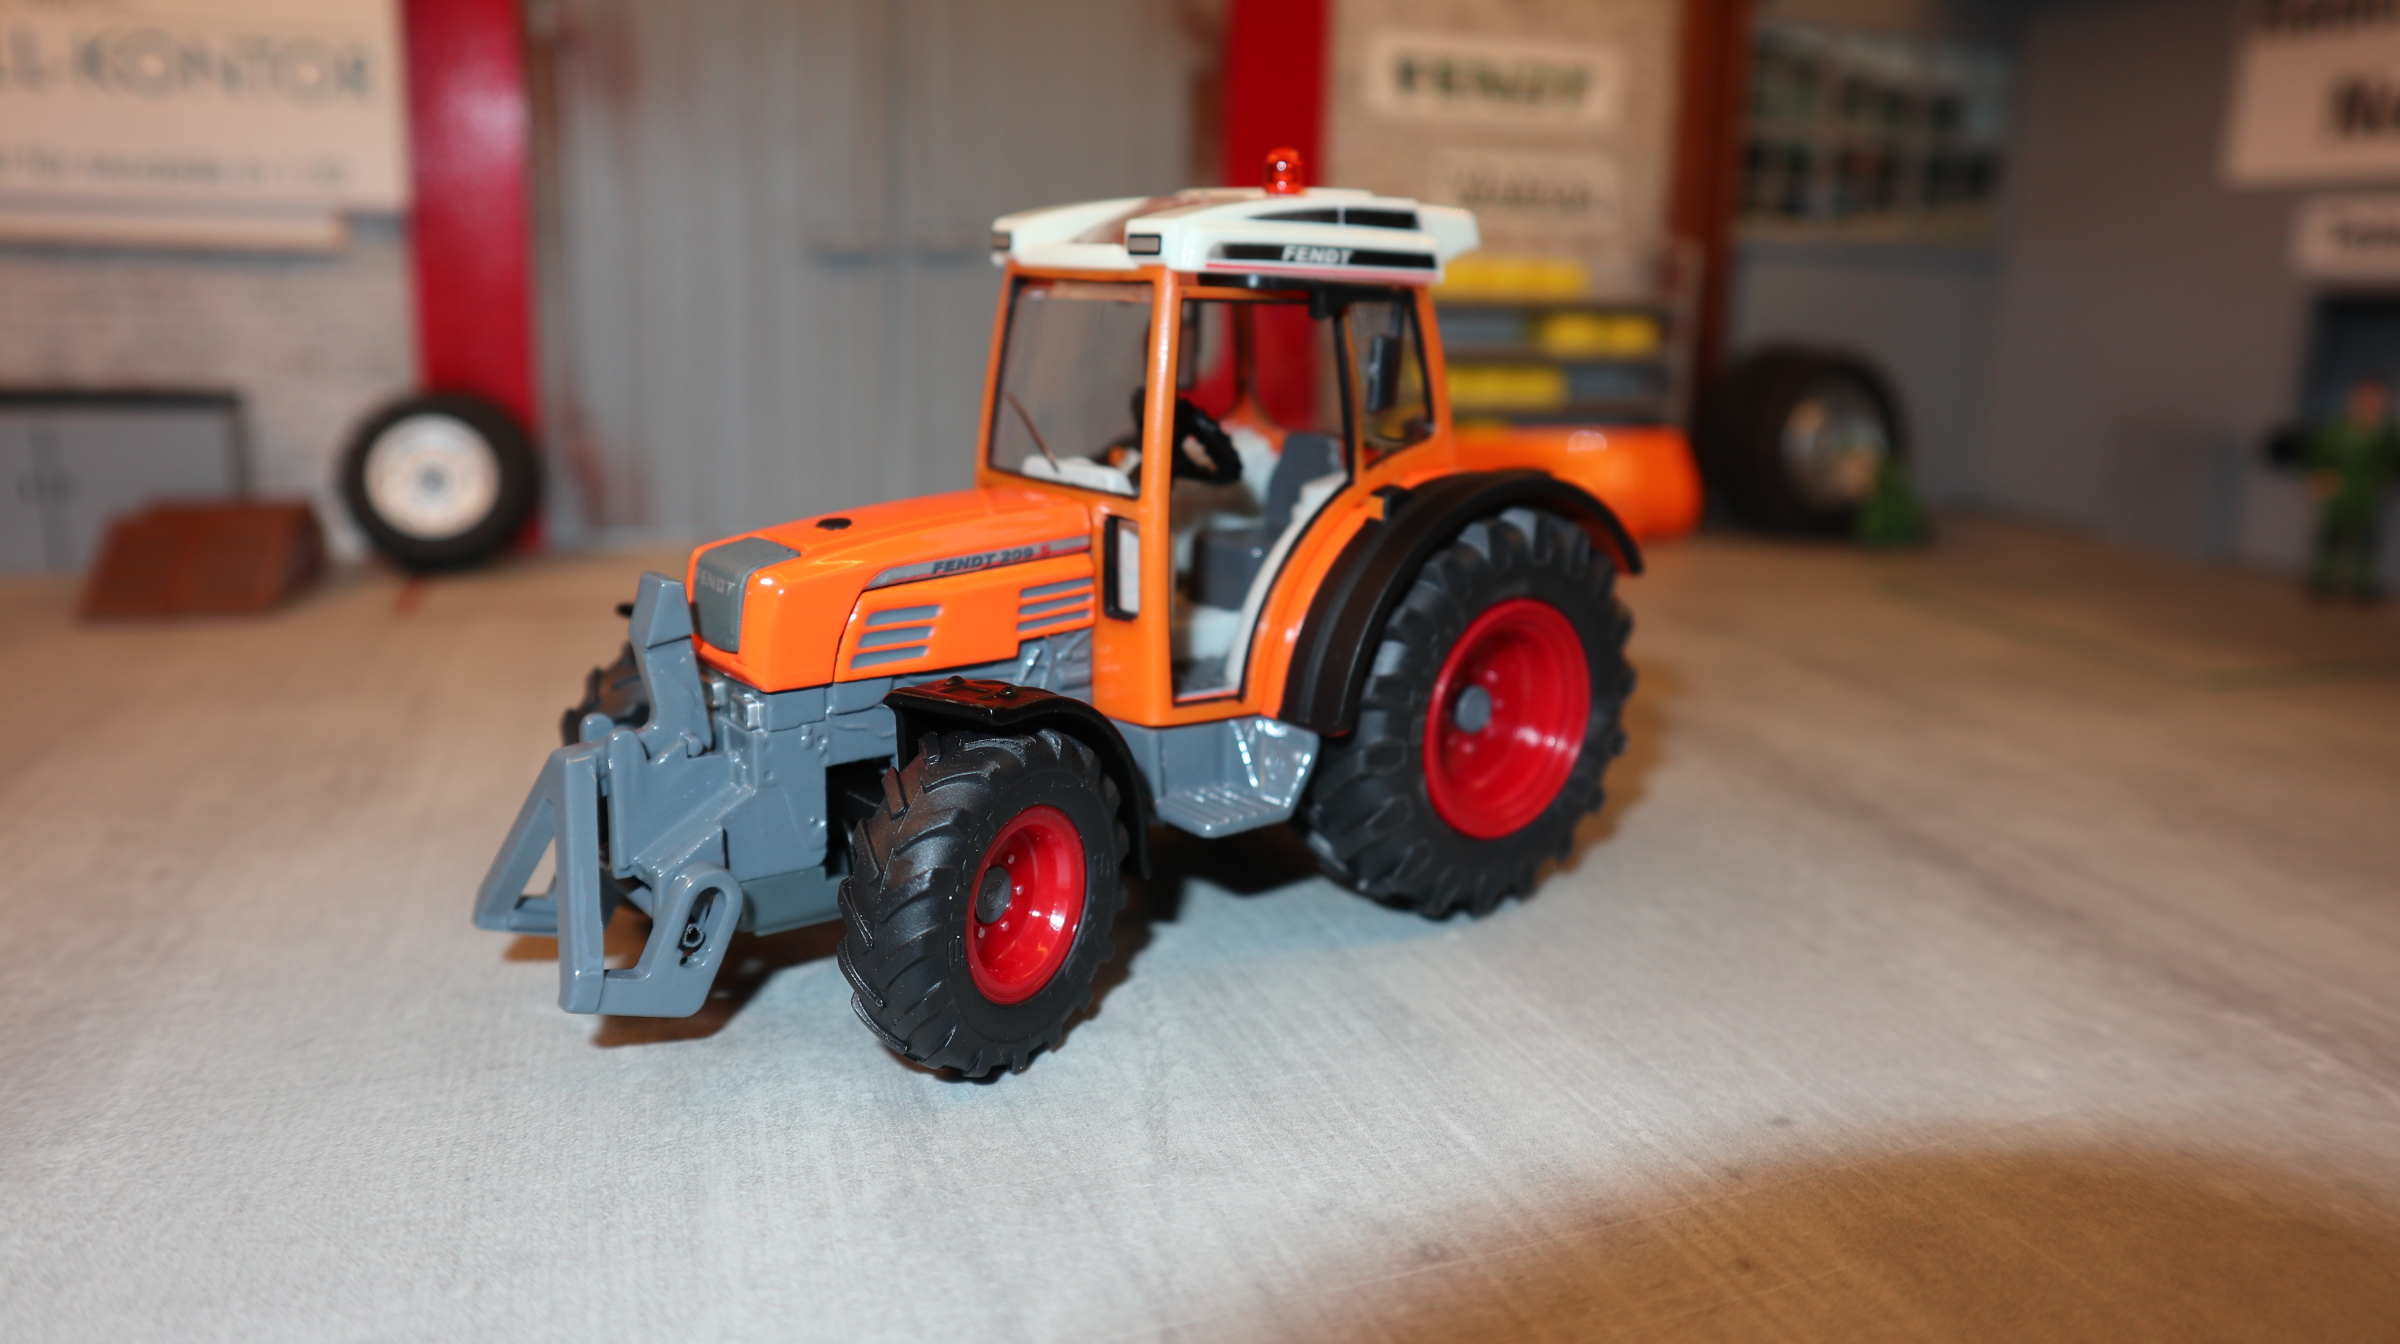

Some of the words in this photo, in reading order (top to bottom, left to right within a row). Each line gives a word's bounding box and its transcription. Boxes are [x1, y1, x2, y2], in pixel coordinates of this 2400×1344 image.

[1281, 244, 1355, 265] FENDT
[931, 552, 996, 575] FENDT
[1000, 546, 1034, 563] 209
[1040, 544, 1052, 558] S
